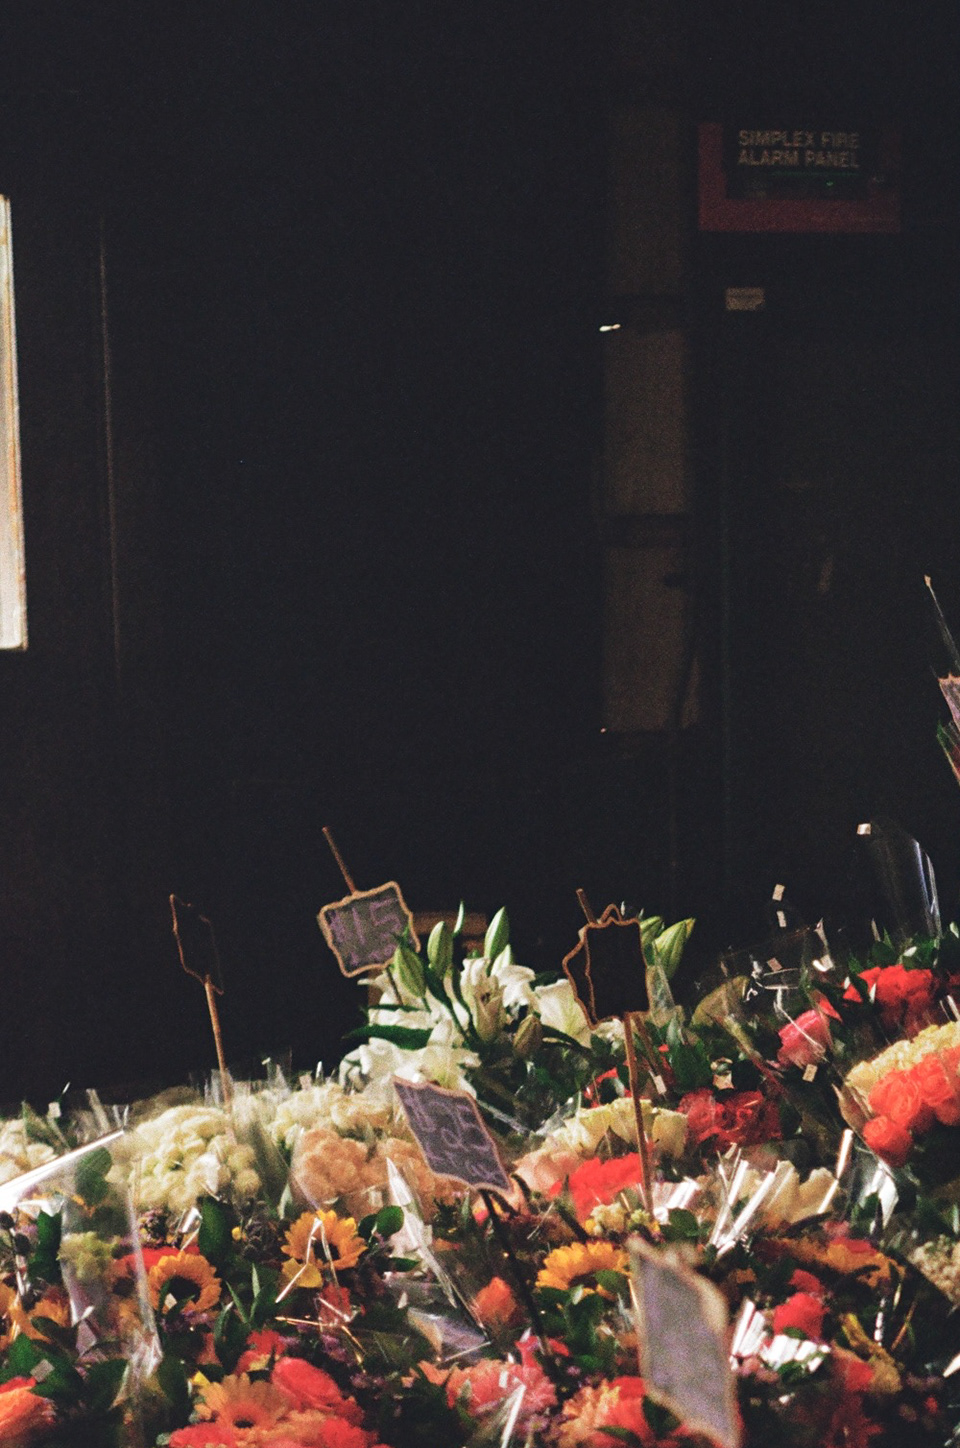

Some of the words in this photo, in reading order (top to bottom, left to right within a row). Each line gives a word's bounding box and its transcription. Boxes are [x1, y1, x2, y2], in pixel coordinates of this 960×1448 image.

[738, 129, 815, 147] SIMPLEX
[821, 131, 860, 149] FIRE
[738, 149, 799, 166] ALARM
[805, 151, 860, 168] PANEL
